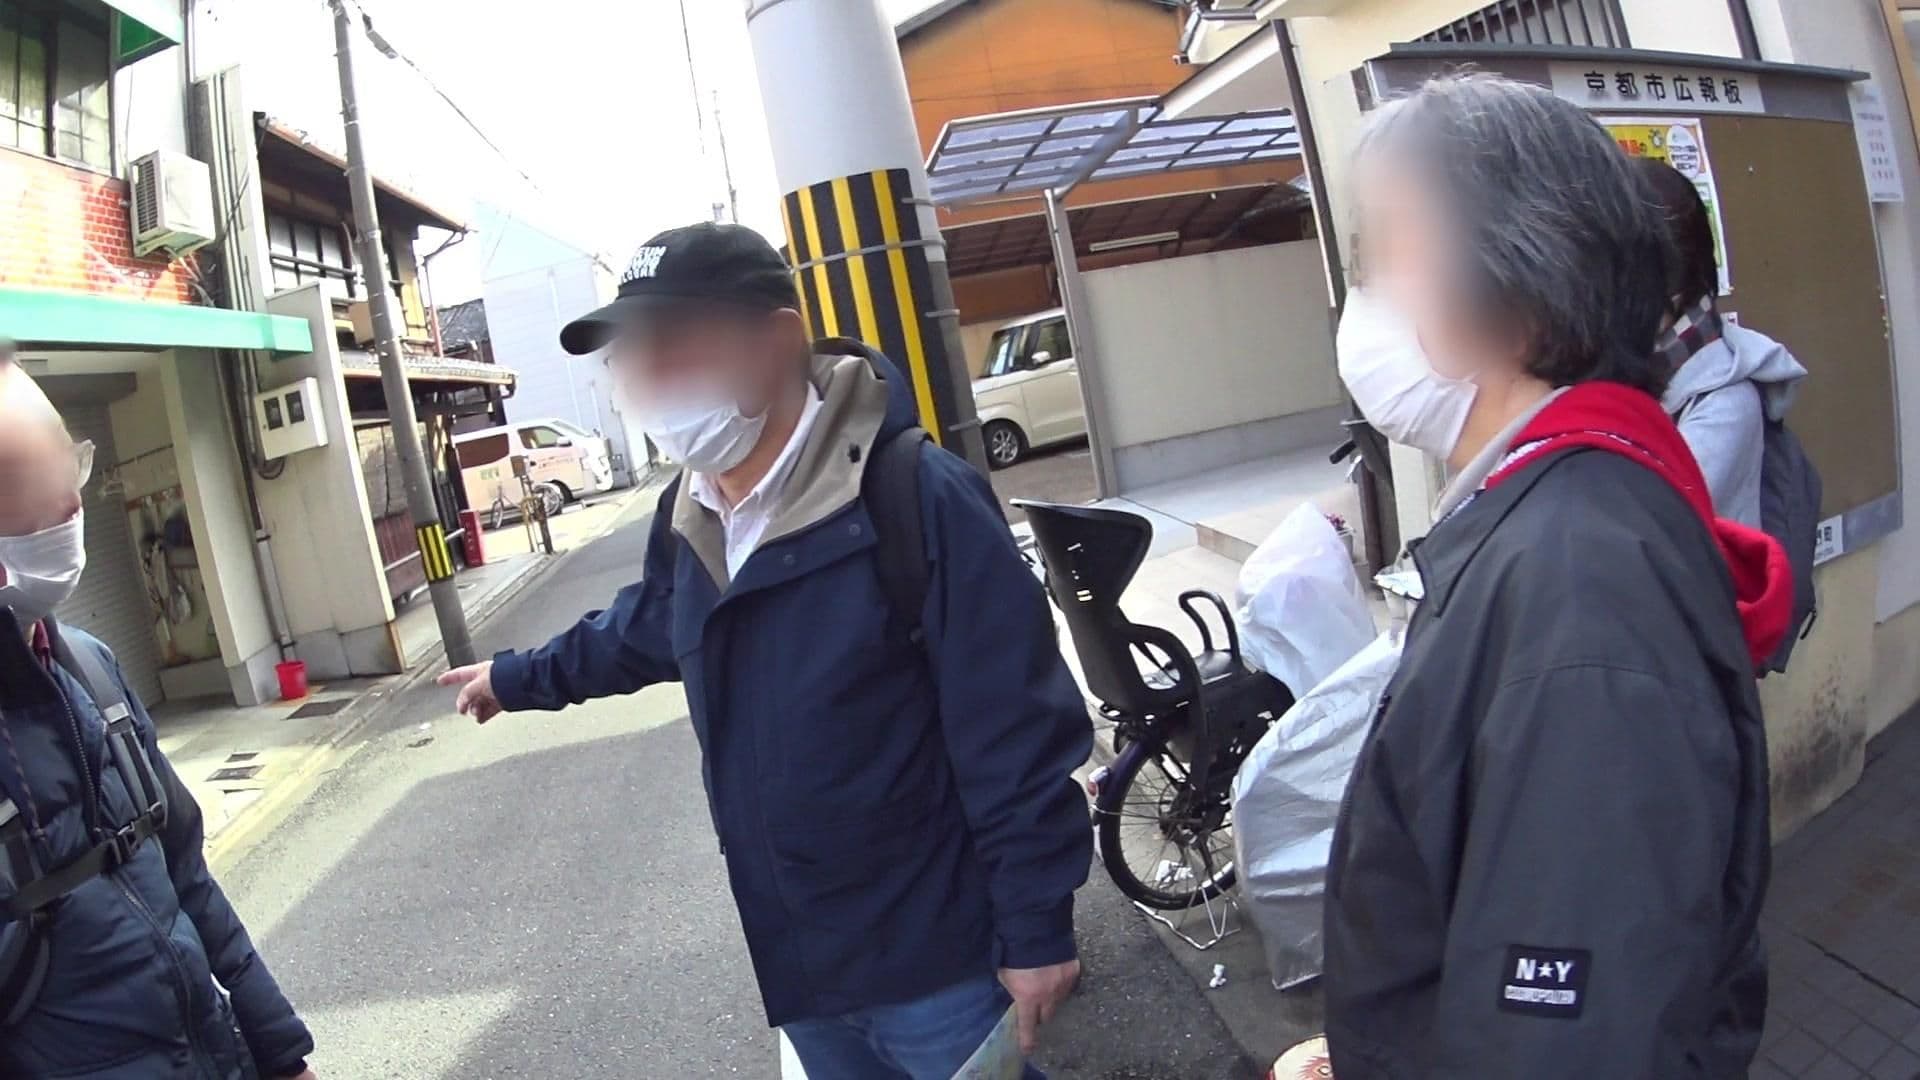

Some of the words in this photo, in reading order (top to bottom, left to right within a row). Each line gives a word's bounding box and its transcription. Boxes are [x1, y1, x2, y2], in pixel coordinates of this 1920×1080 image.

[1584, 71, 1742, 104] 京都市広報板
